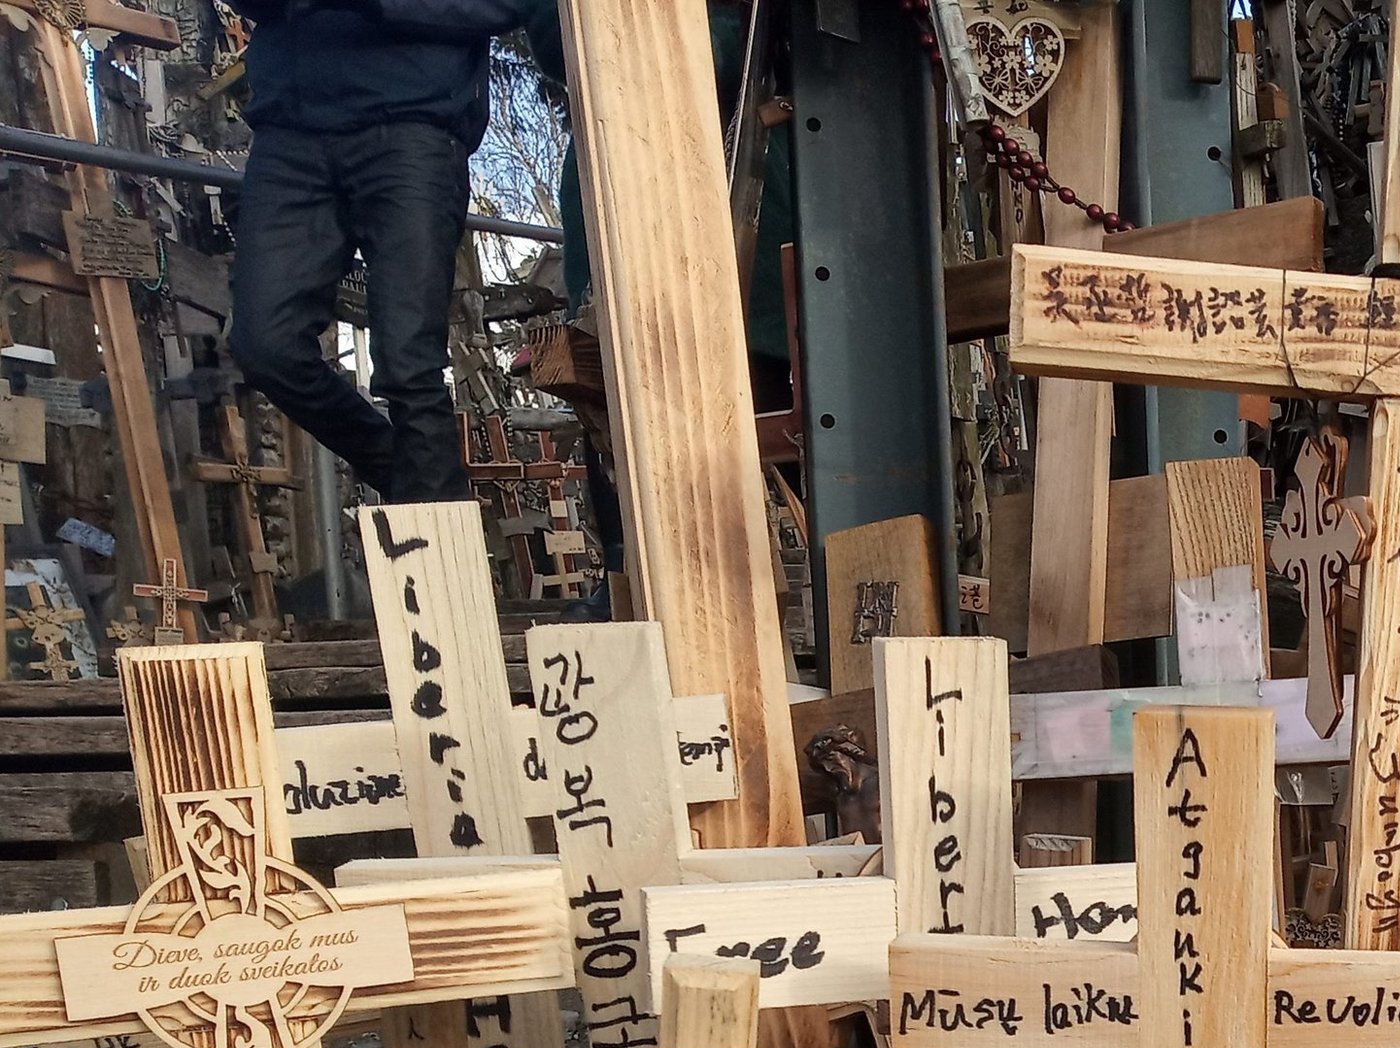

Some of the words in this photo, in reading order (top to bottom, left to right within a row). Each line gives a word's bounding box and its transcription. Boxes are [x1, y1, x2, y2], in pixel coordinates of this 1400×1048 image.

[113, 940, 203, 971] Dieve,
[213, 928, 302, 962] saugok
[309, 928, 359, 947] mus
[138, 975, 161, 993] ir
[169, 962, 231, 989] duok
[239, 953, 344, 983] sveikatos
